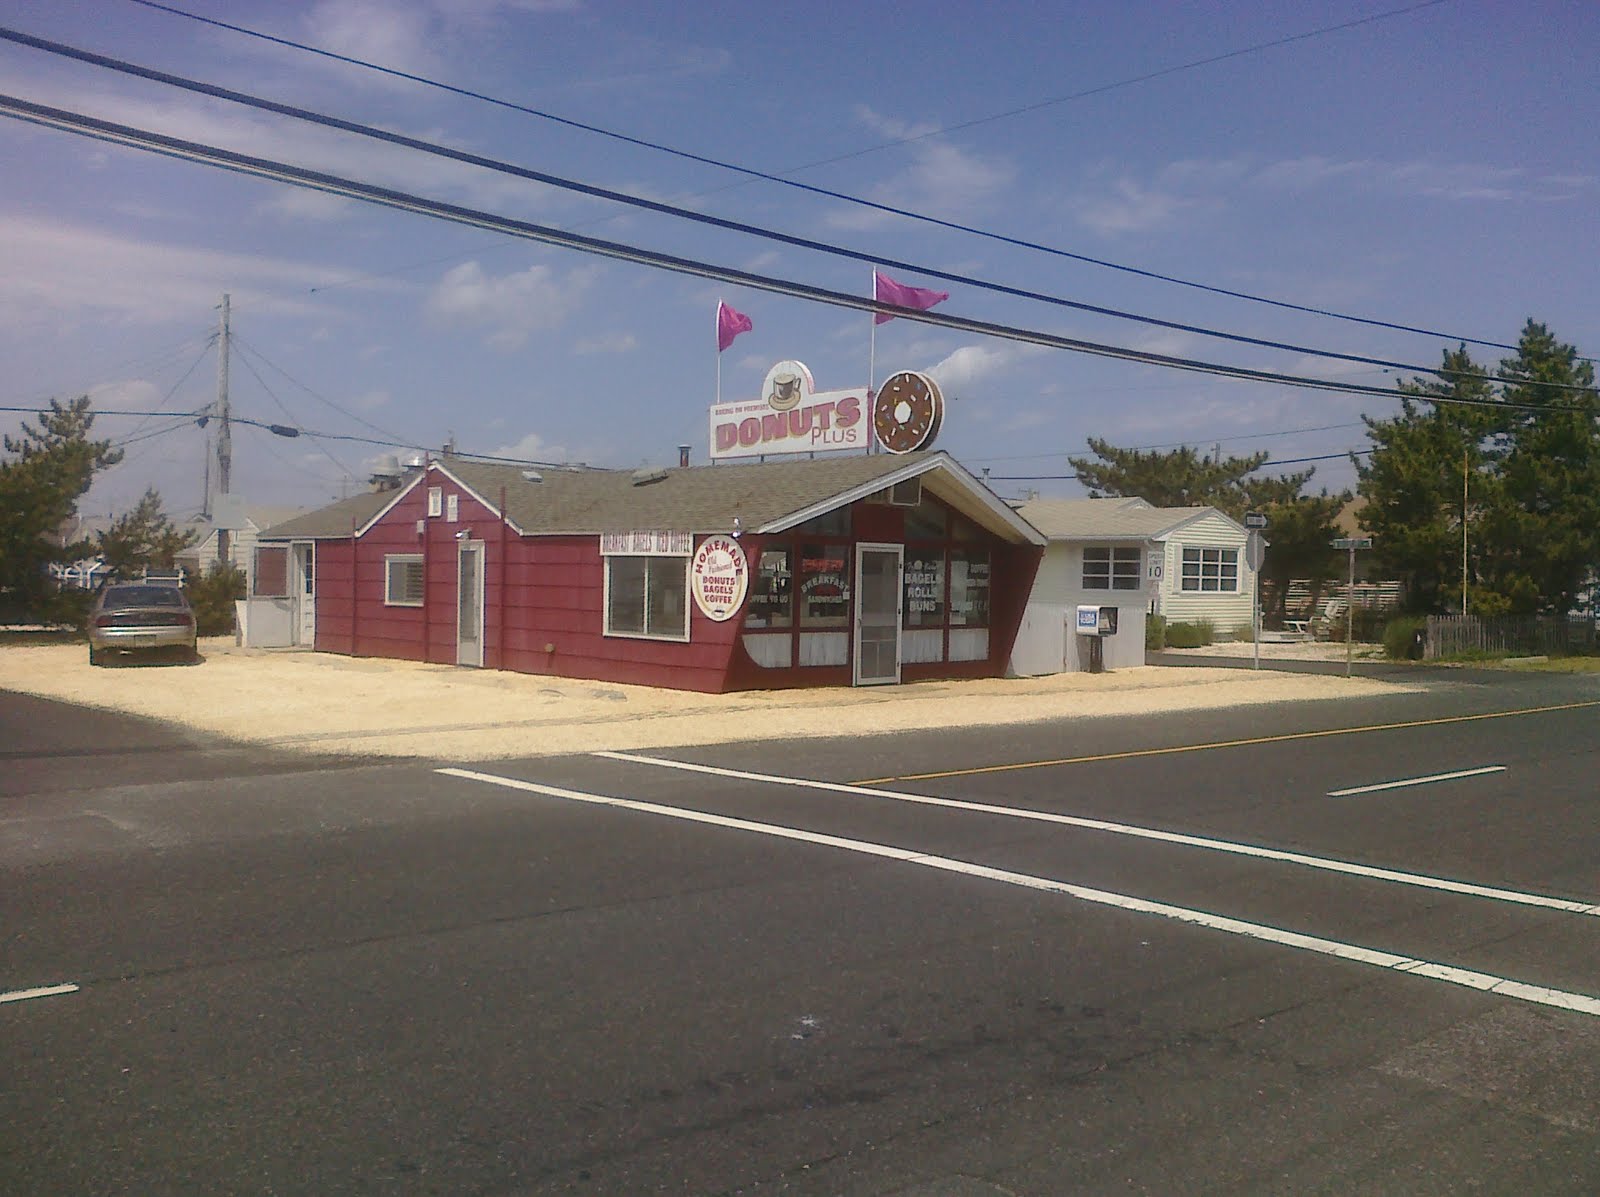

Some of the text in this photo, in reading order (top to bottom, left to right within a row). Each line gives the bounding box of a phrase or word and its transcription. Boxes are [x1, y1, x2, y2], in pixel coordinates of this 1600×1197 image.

[715, 396, 861, 451] DONUTS
[811, 426, 857, 446] PLUS
[602, 531, 690, 553] BREAKFAST BAGELS ICED COFFEE
[695, 540, 743, 577] HOMEMADE
[1148, 566, 1162, 578] 10
[702, 576, 735, 586] DONUTS
[801, 574, 849, 594] BREAKFAST
[904, 573, 943, 584] BAGELS
[703, 585, 734, 595] BAGELS
[907, 586, 937, 598] ROLLS
[704, 594, 733, 604] COFFEE
[909, 600, 936, 612] BUNS
